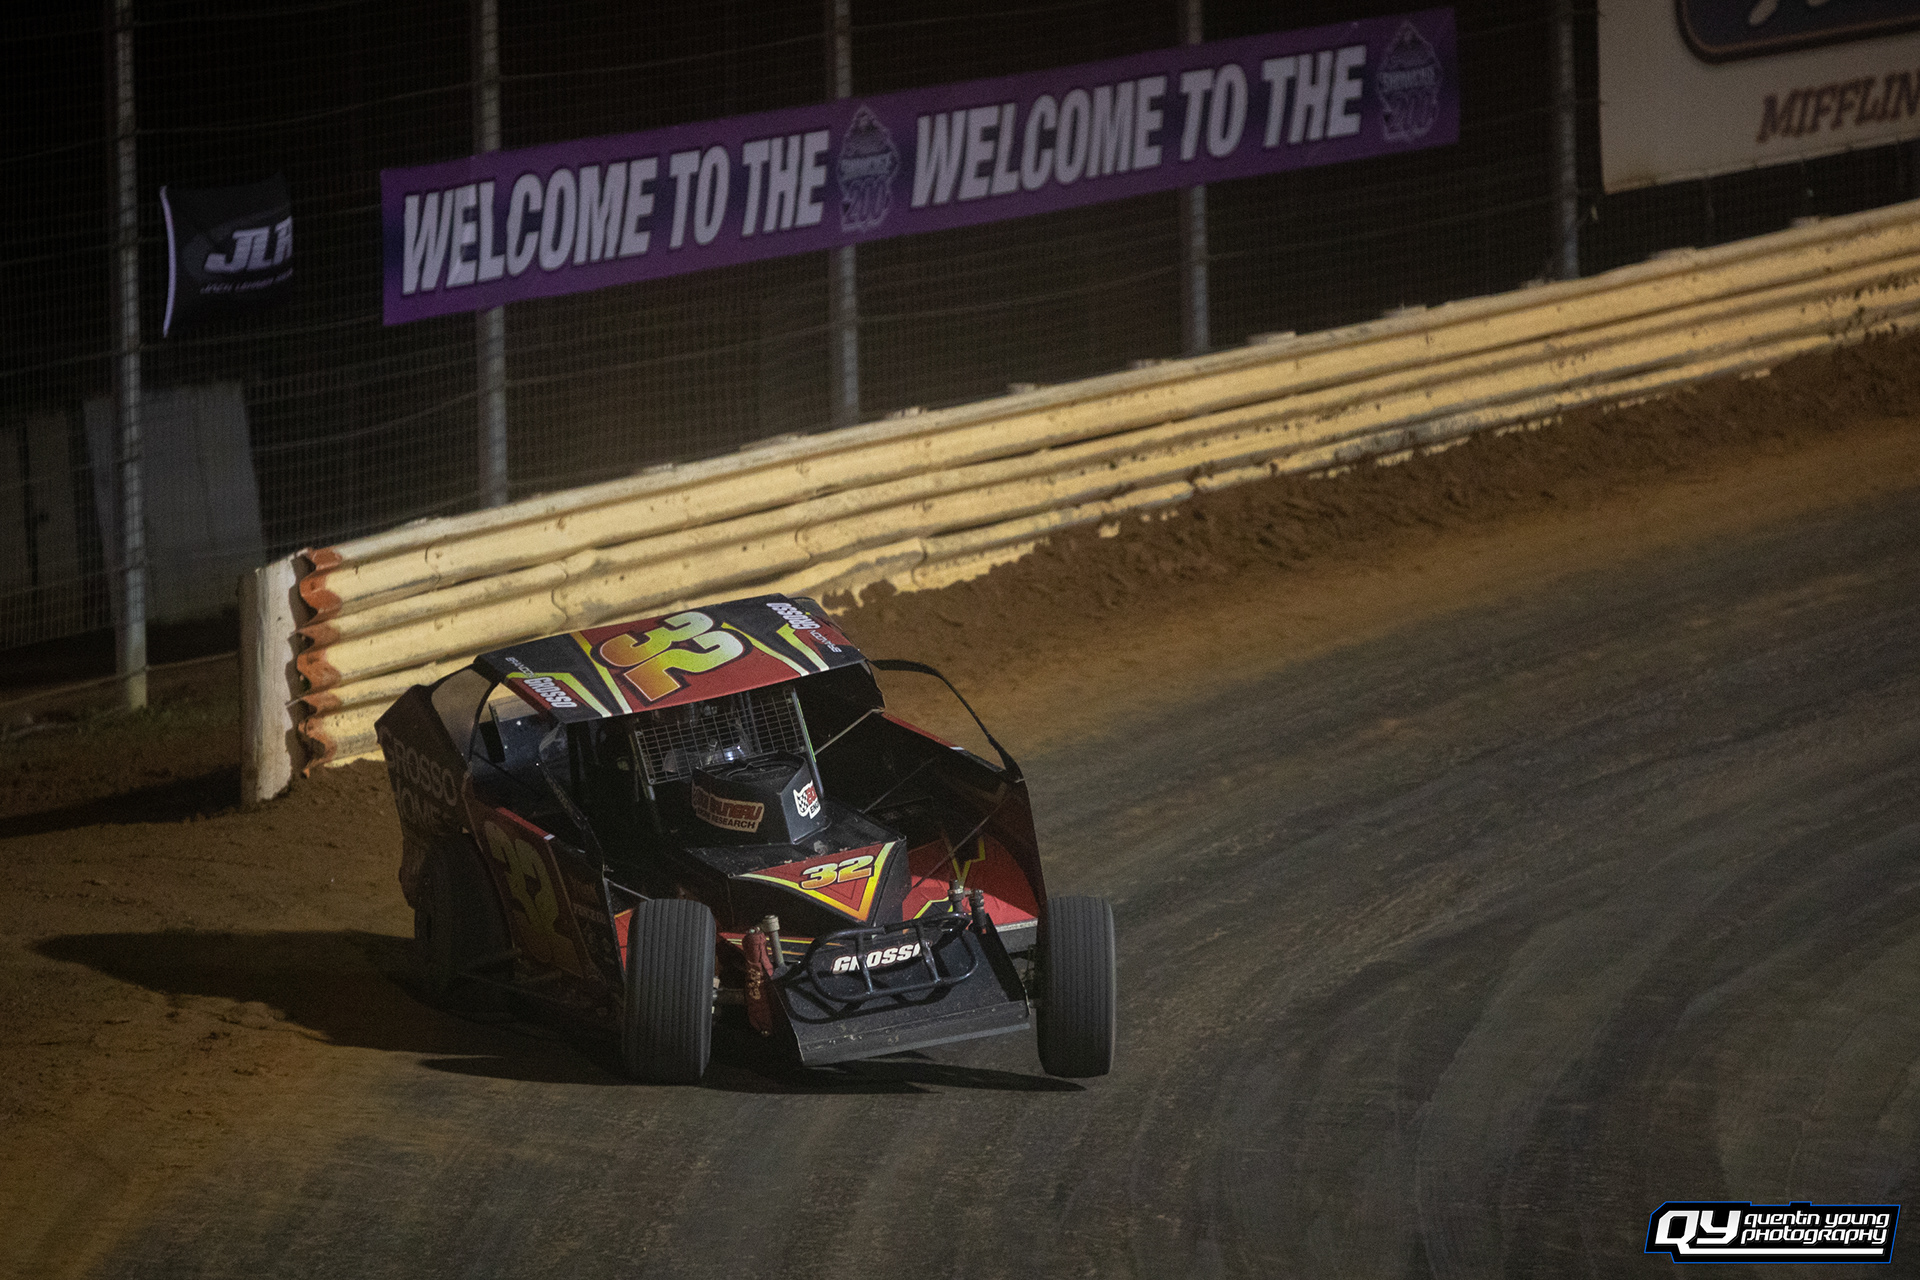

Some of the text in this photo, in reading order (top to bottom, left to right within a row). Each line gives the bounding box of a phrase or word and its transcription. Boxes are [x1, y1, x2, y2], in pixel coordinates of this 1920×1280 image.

[911, 45, 1367, 208] WELCOME TO THE
[402, 129, 831, 295] WELCOME TO THE
[766, 602, 822, 630] GROSSO
[600, 611, 744, 701] 32
[523, 677, 578, 708] GROSSO
[711, 813, 756, 830] RESEARCH
[801, 855, 875, 890] 32
